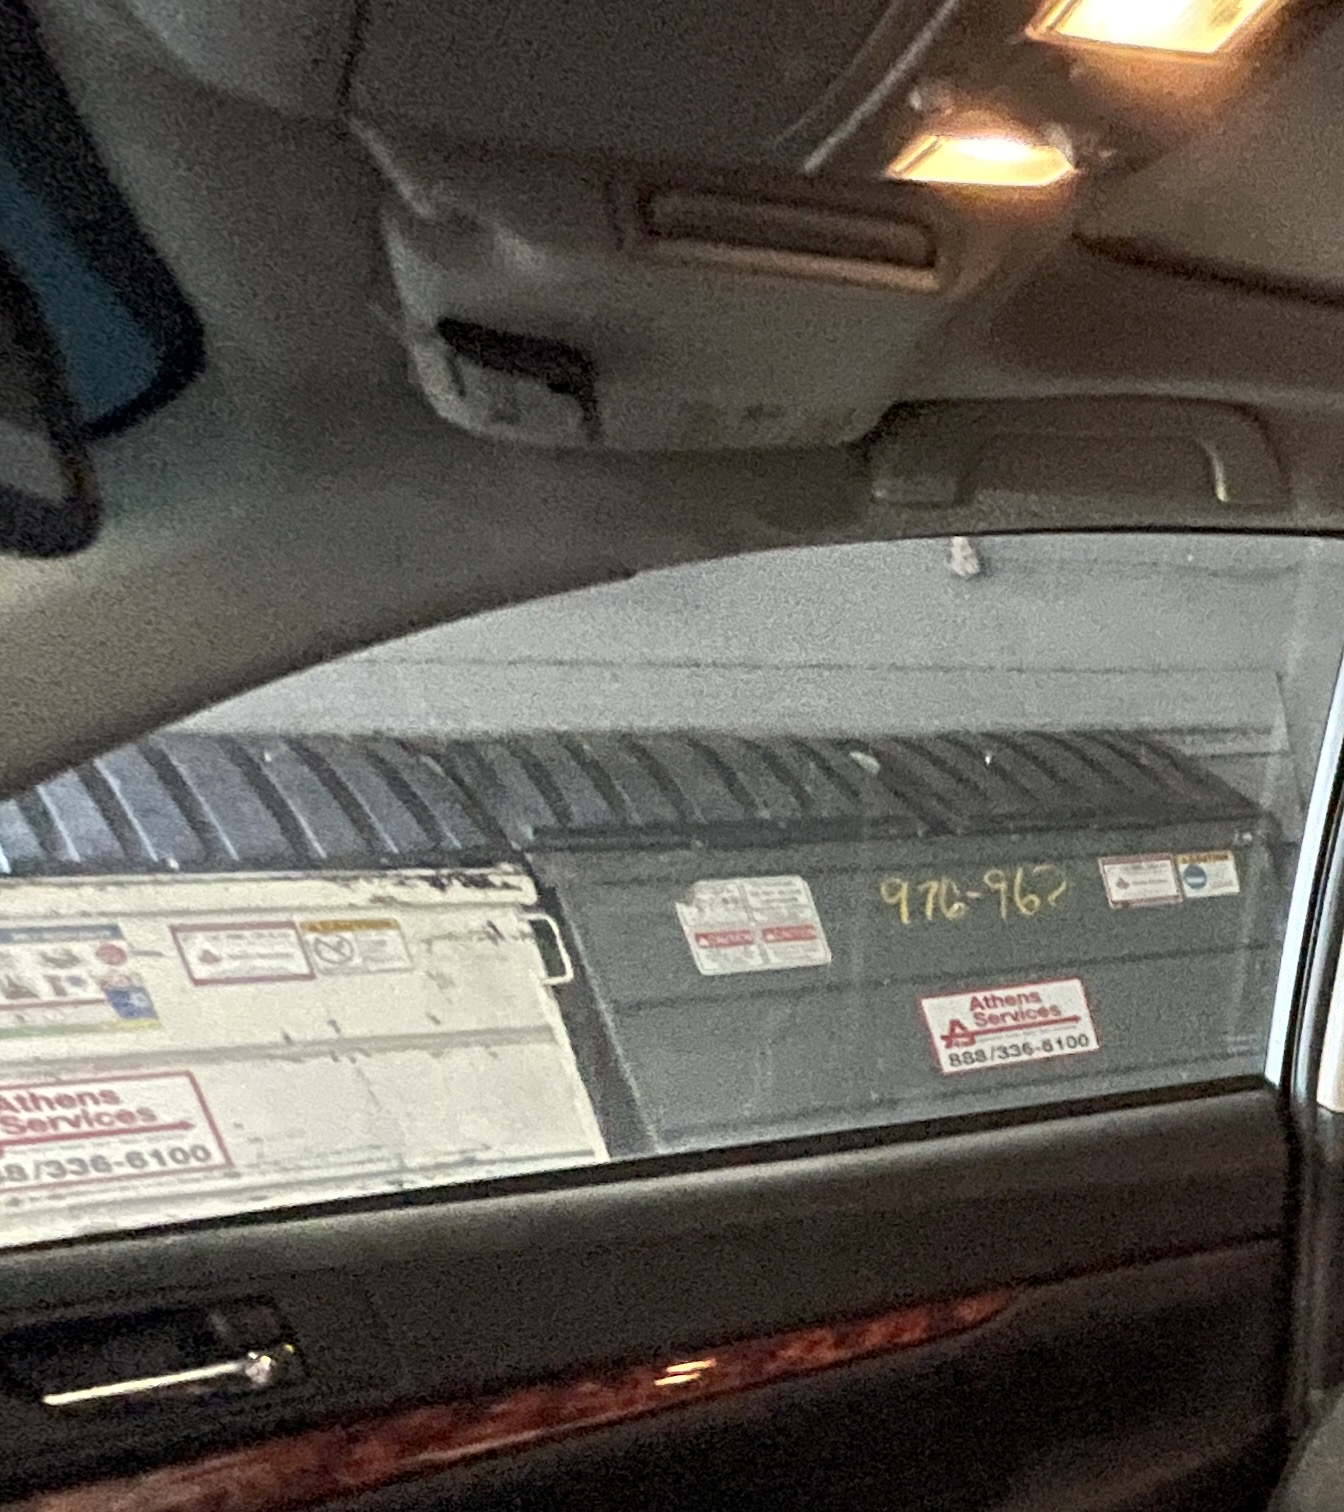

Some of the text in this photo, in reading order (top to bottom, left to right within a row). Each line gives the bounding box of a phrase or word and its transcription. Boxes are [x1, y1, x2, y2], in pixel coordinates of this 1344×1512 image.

[970, 990, 1042, 1011] Athens
[972, 1004, 1061, 1028] Services
[0, 1107, 157, 1135] Services
[0, 1144, 212, 1182] 8/336-6100
